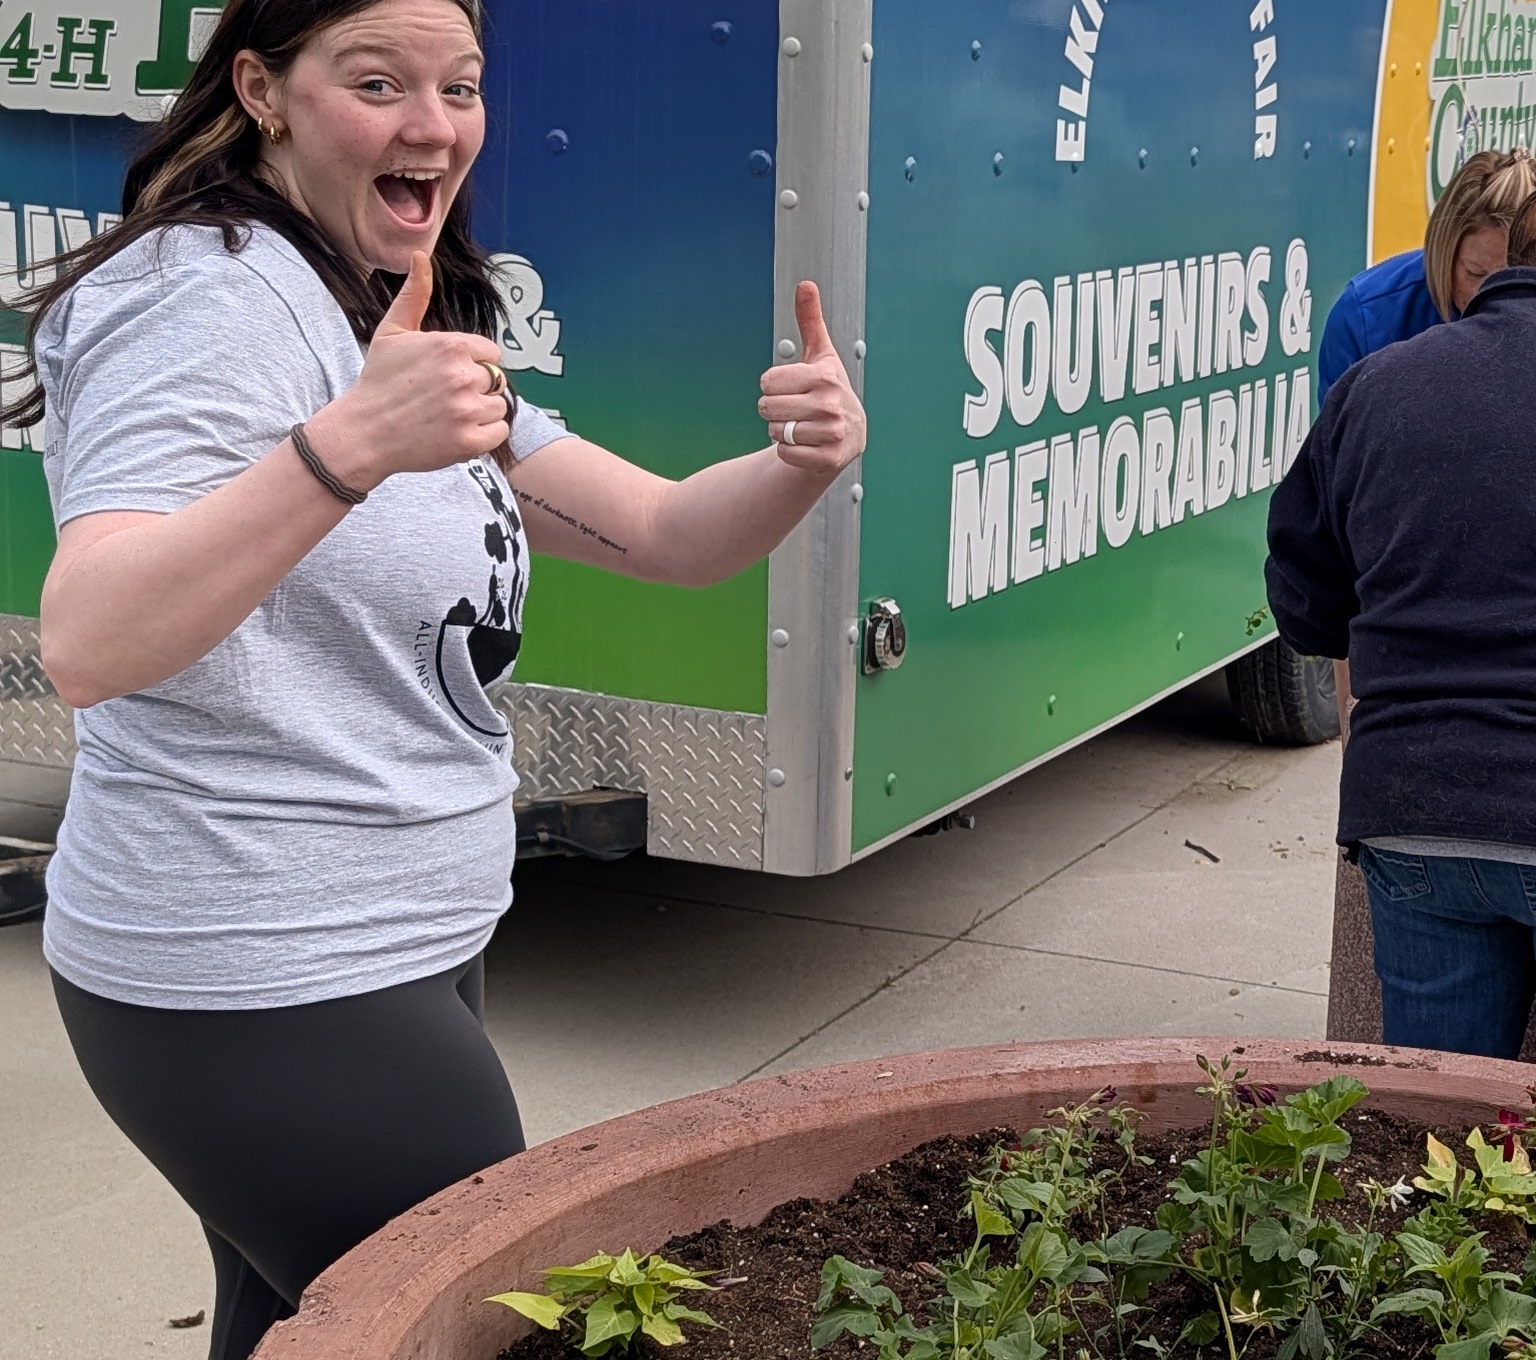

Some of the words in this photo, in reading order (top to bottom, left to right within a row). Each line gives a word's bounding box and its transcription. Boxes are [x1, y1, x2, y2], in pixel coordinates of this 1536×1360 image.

[481, 252, 564, 377] &
[962, 246, 1272, 438] SOUVENIRS
[1279, 238, 1312, 356] &
[946, 366, 1311, 610] MEMORABILIA
